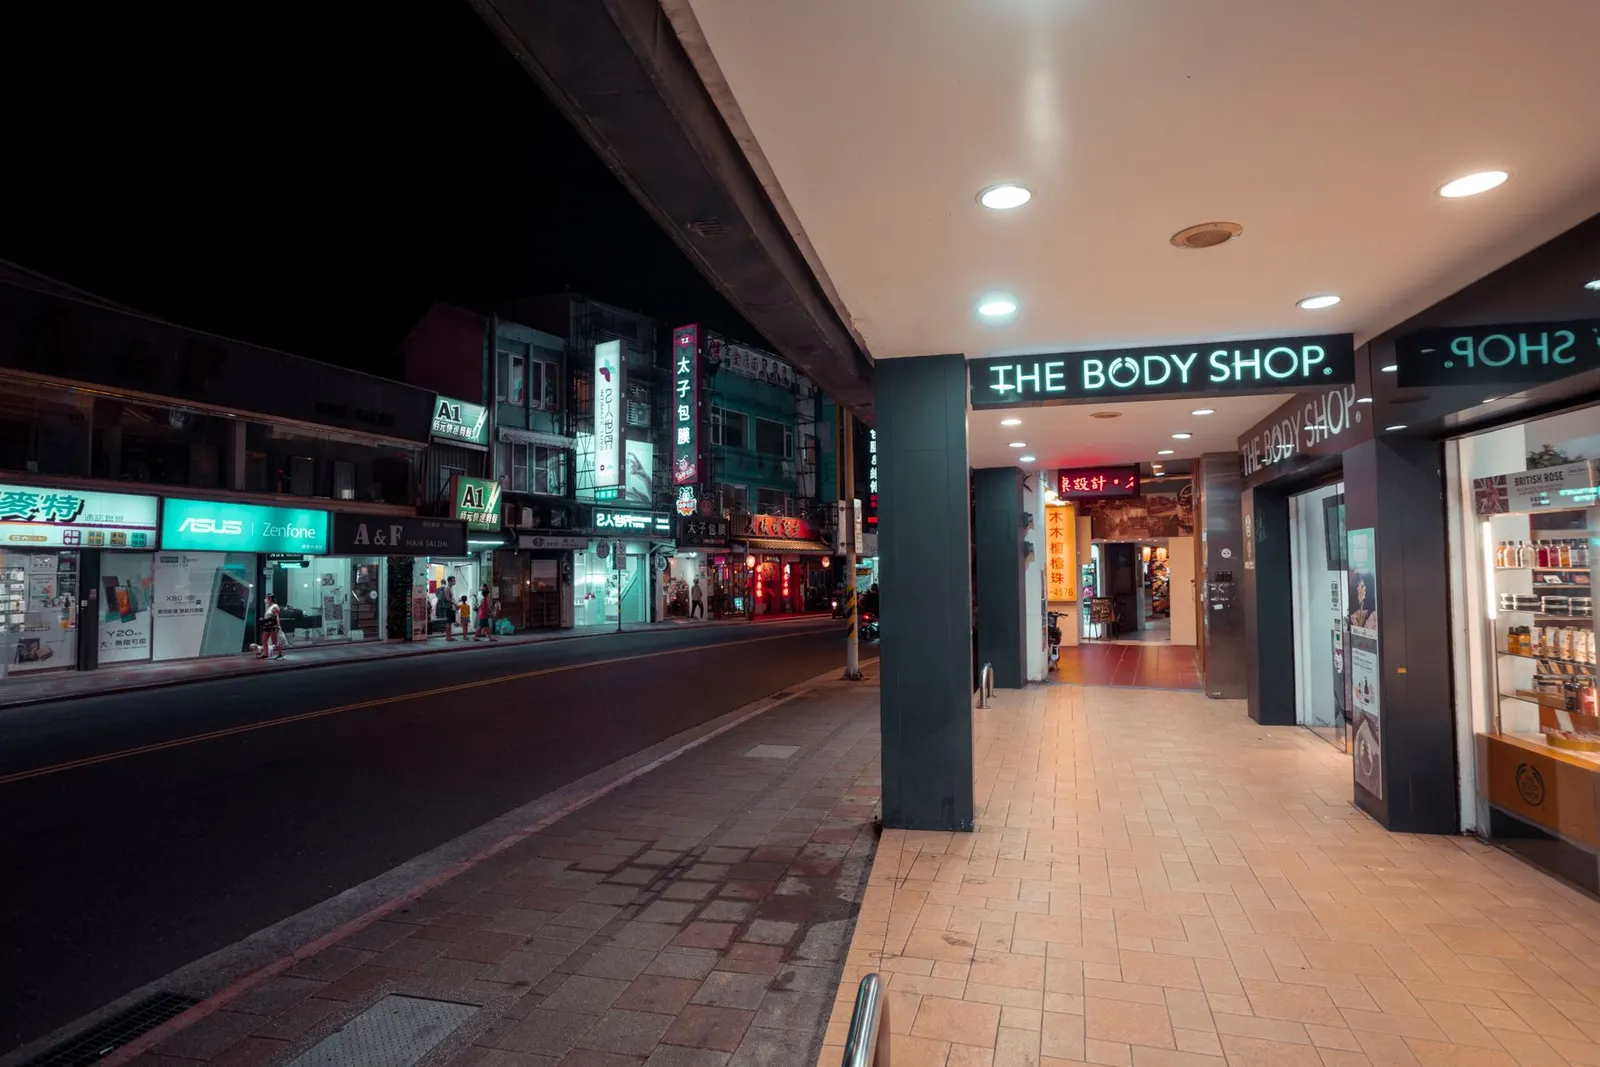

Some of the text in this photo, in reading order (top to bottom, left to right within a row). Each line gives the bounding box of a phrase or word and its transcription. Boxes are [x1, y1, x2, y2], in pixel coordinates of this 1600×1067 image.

[989, 361, 1066, 394] THE
[1083, 352, 1198, 389] BODY
[436, 400, 462, 423] A1
[676, 356, 691, 445] 太子包膜
[1242, 435, 1262, 476] THE
[1263, 410, 1300, 465] BODY
[1514, 474, 1542, 486] BRITISH
[1544, 471, 1564, 482] ROSE
[461, 484, 485, 509] A1
[178, 517, 243, 535] ASUS
[262, 522, 316, 539] Zenfone
[354, 523, 403, 546] A & F
[407, 539, 425, 547] HAIR
[107, 629, 134, 637] Y20
